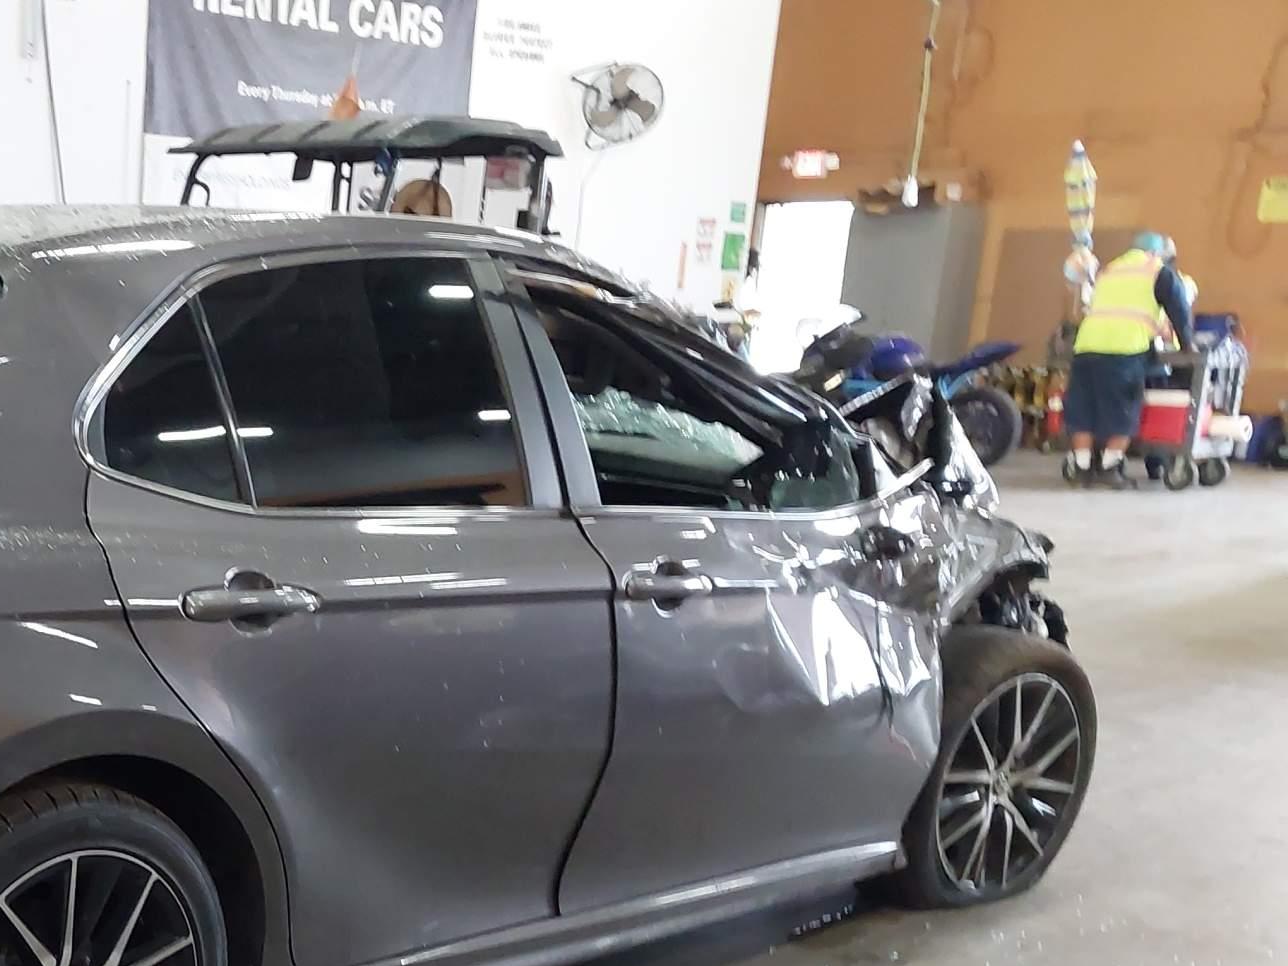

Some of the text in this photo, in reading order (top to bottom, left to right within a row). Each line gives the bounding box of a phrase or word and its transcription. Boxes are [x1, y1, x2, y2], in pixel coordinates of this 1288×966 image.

[348, 0, 444, 48] CARS
[237, 80, 270, 102] Every
[271, 85, 319, 108] Thursday
